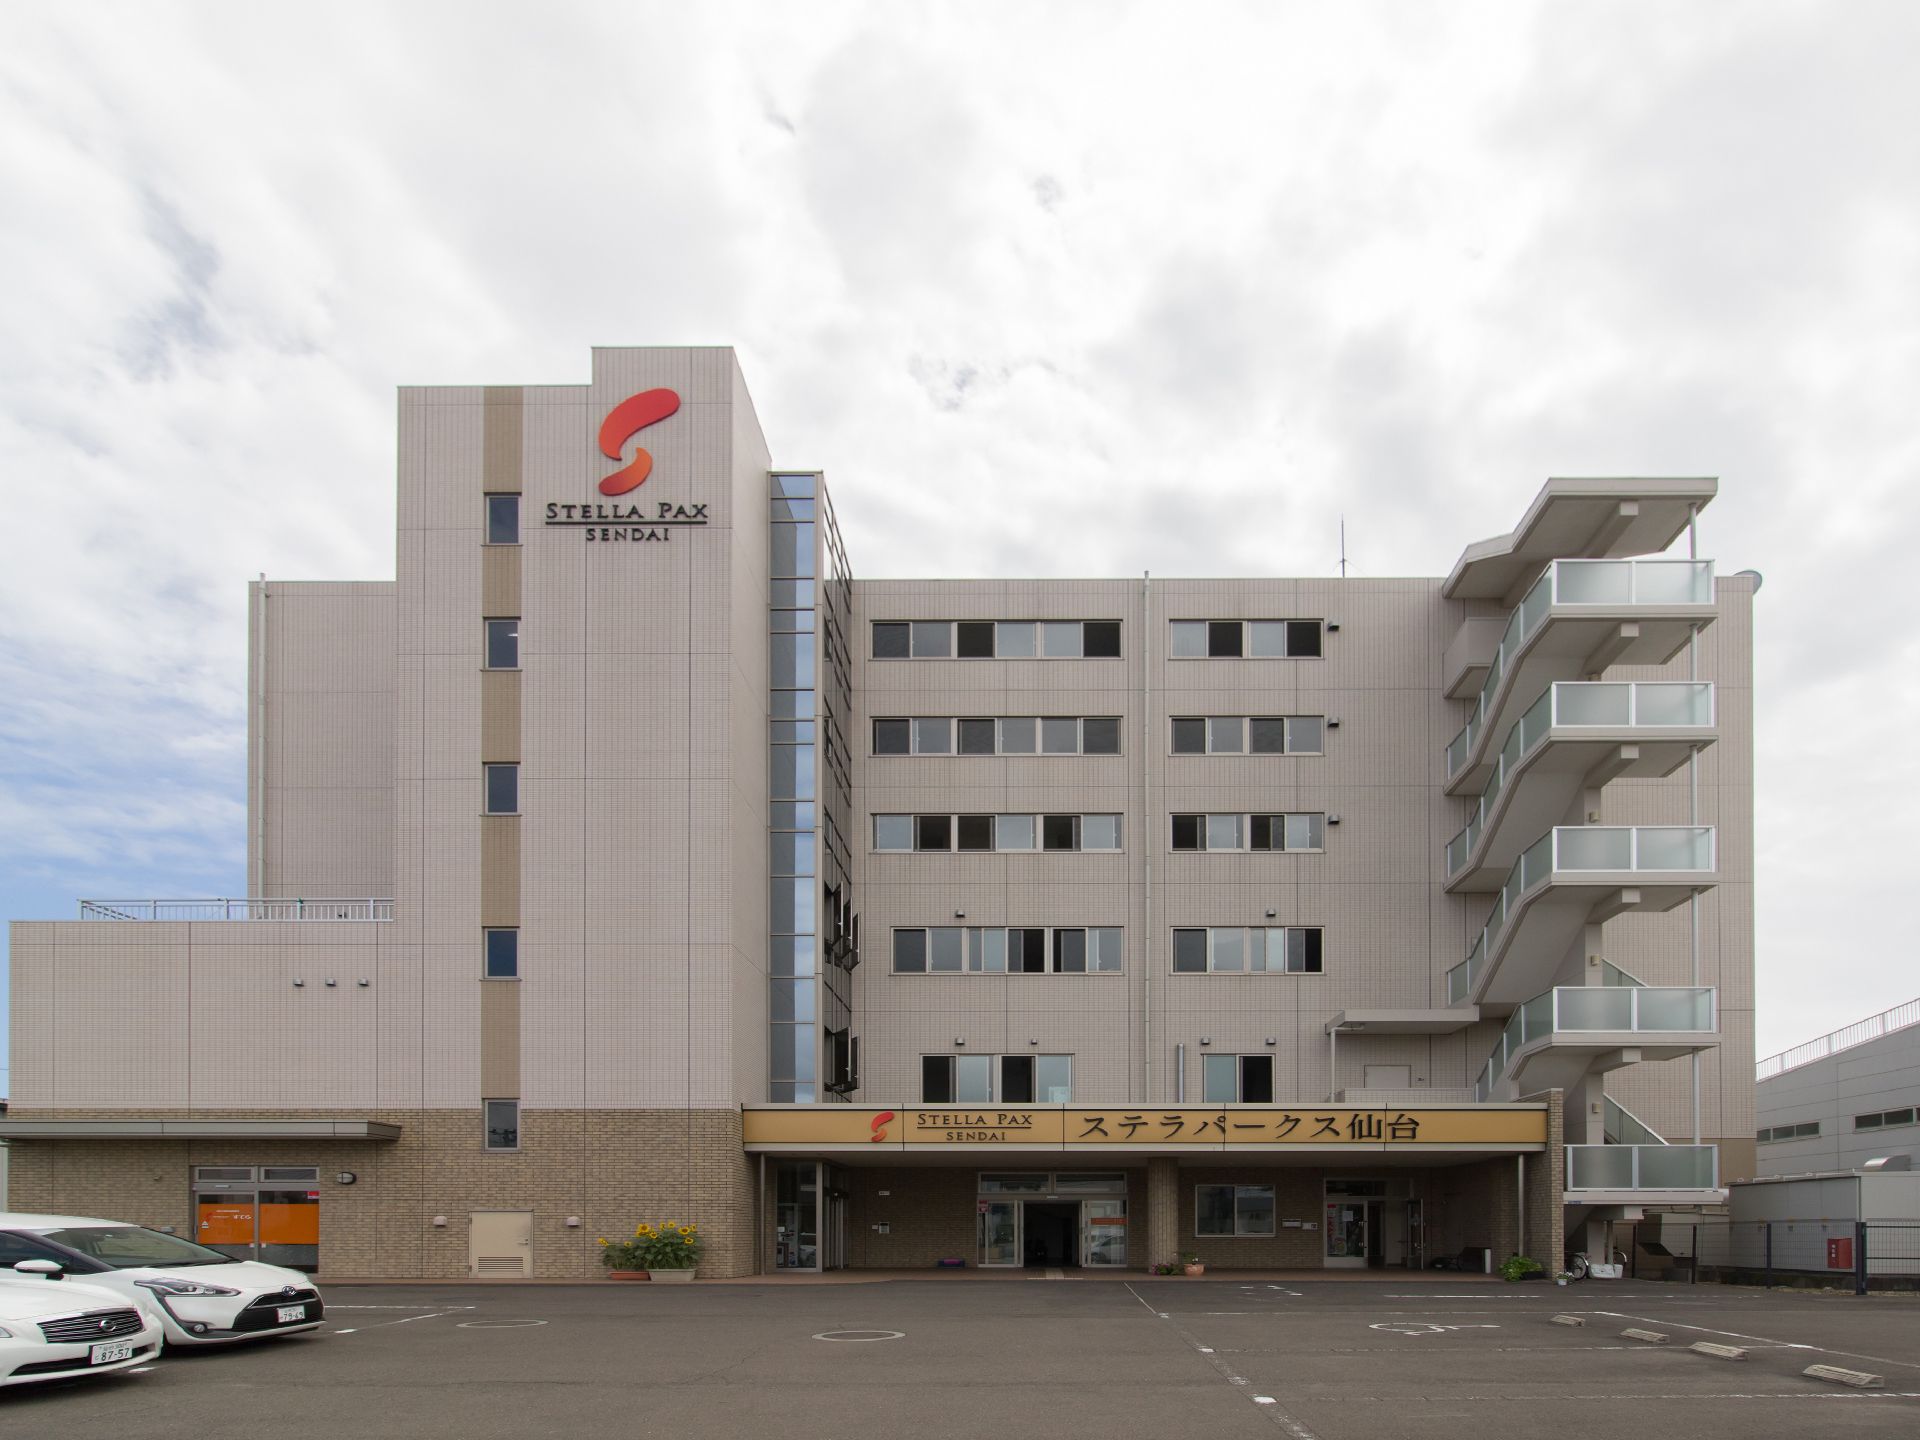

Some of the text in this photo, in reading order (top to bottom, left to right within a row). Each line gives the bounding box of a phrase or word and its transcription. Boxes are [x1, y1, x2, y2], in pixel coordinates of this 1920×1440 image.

[546, 502, 708, 519] STELLA PAX
[586, 528, 670, 541] SENDAI
[917, 1113, 1033, 1125] STELLA PAX
[1078, 1113, 1420, 1140] ステラパークス仙台
[946, 1131, 1006, 1141] SENDAI
[101, 1347, 130, 1361] 87-57
